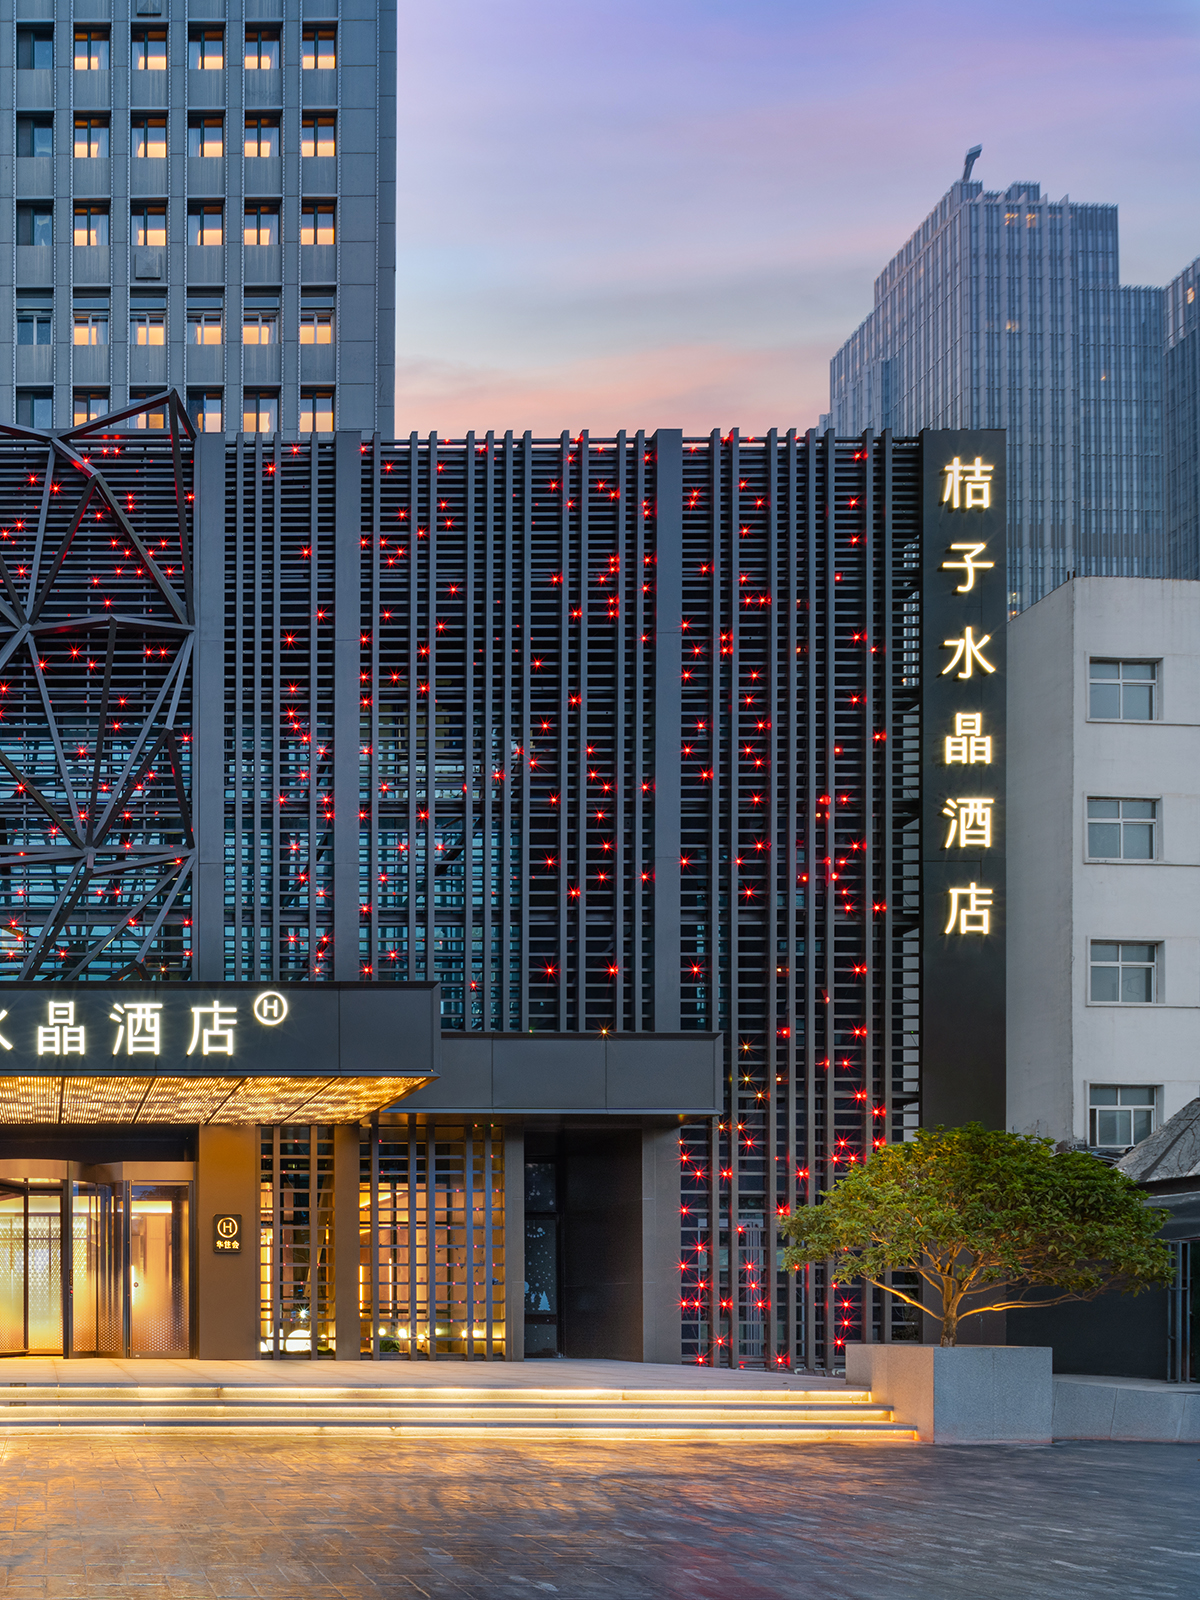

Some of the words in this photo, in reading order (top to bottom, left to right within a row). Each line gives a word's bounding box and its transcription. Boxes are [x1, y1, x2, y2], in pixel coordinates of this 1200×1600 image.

[941, 456, 996, 935] 桔子水晶酒店
[217, 1240, 240, 1249] 华住会
